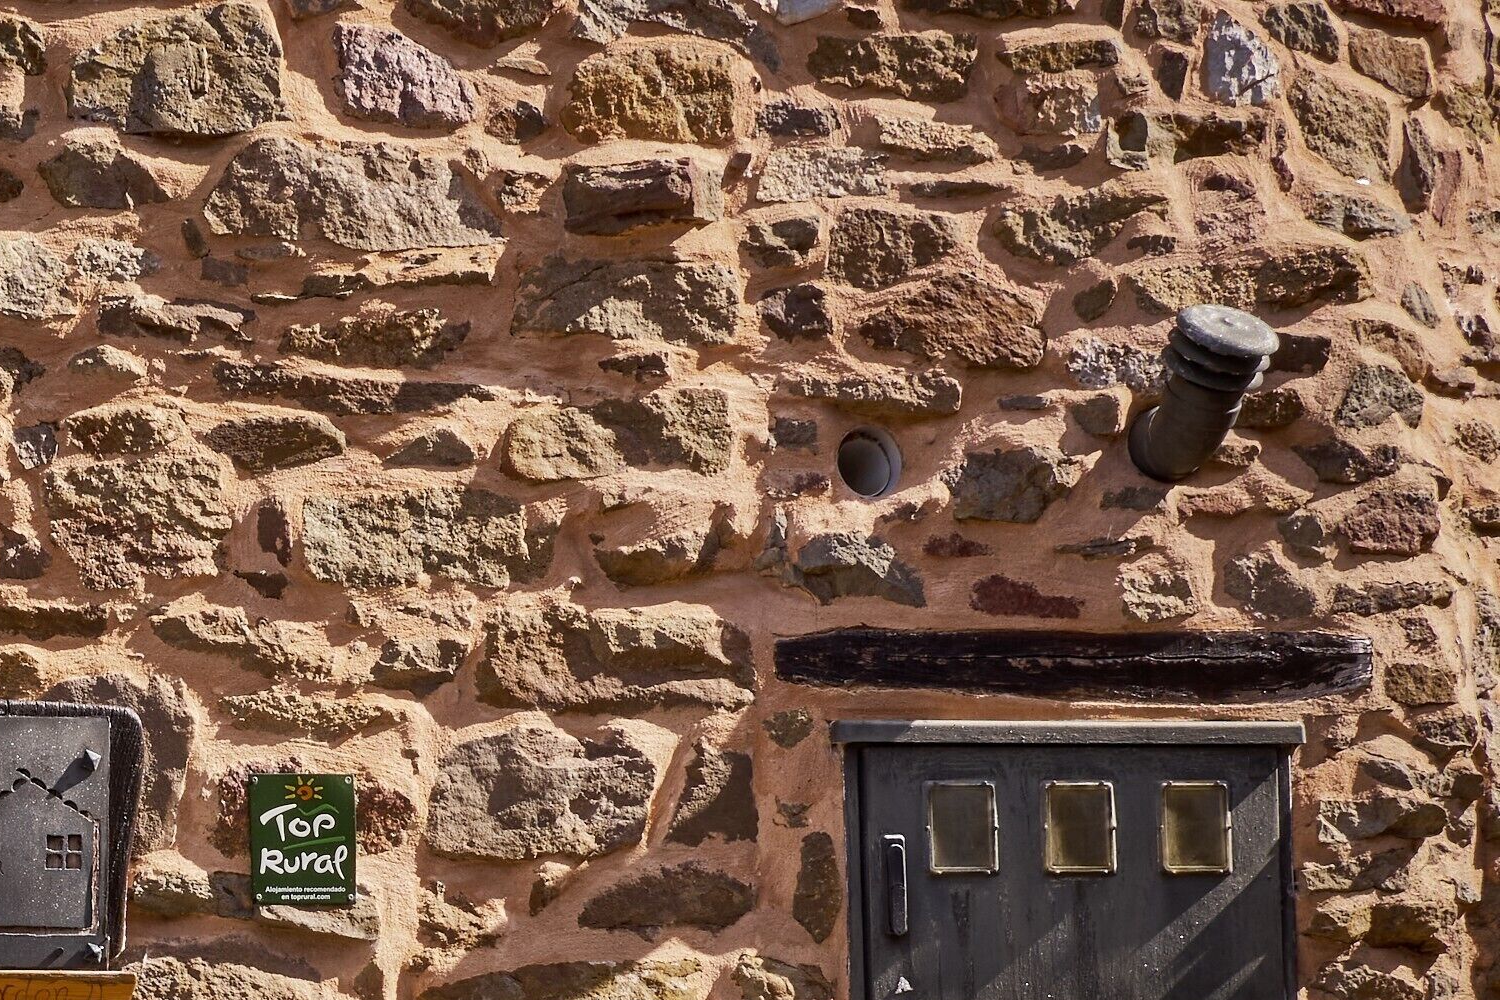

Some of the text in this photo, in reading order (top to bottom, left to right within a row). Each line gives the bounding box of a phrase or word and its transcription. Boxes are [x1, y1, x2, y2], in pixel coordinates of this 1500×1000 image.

[259, 803, 336, 842] Top
[259, 845, 348, 880] Rural
[265, 886, 303, 894] Alojamiento
[290, 893, 331, 901] toprural.com
